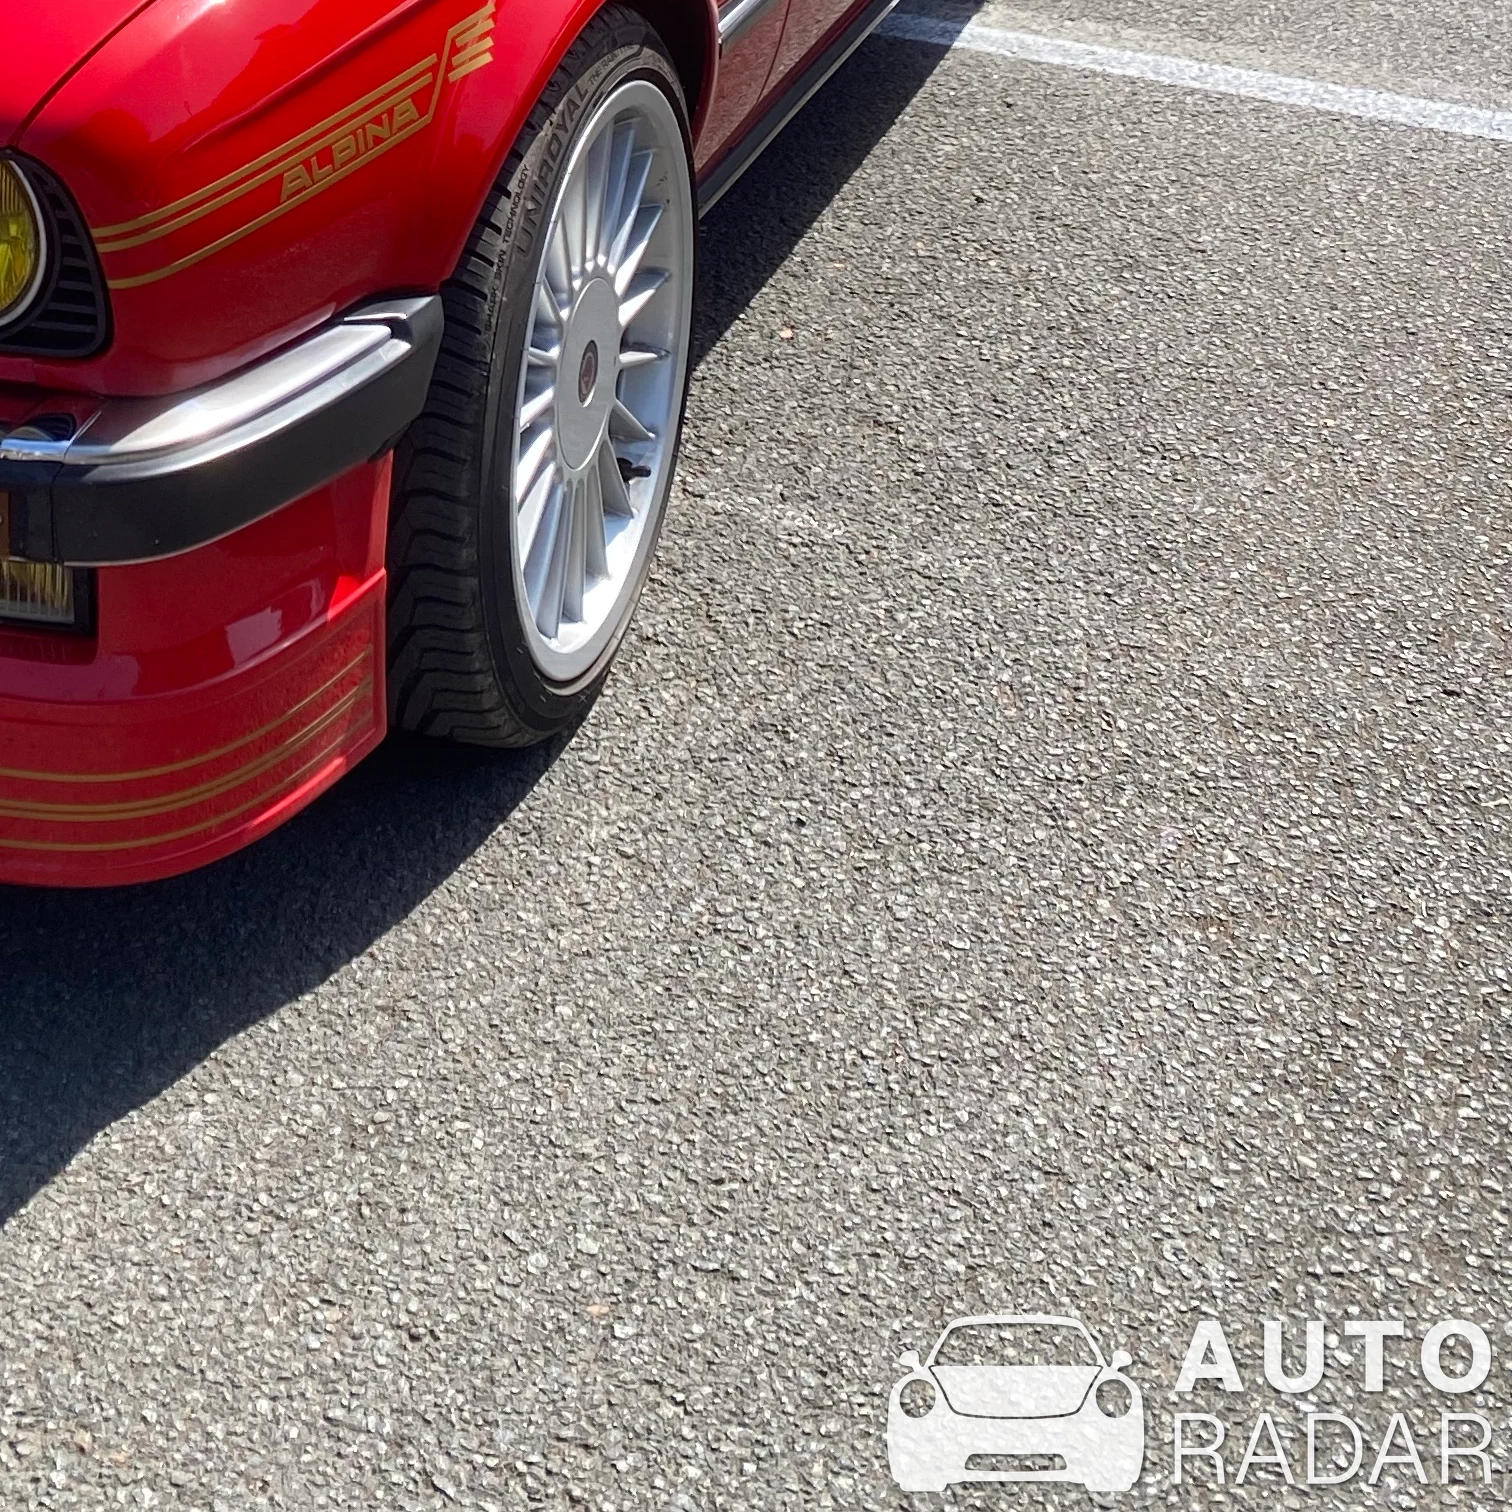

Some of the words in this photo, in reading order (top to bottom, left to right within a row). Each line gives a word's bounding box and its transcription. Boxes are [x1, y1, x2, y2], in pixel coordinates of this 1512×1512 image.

[279, 99, 420, 204] ALPINA
[516, 83, 589, 258] UNIROYAL
[484, 286, 499, 331] SHARK
[494, 249, 507, 281] SKIN
[502, 163, 530, 244] TECHNOLOGY
